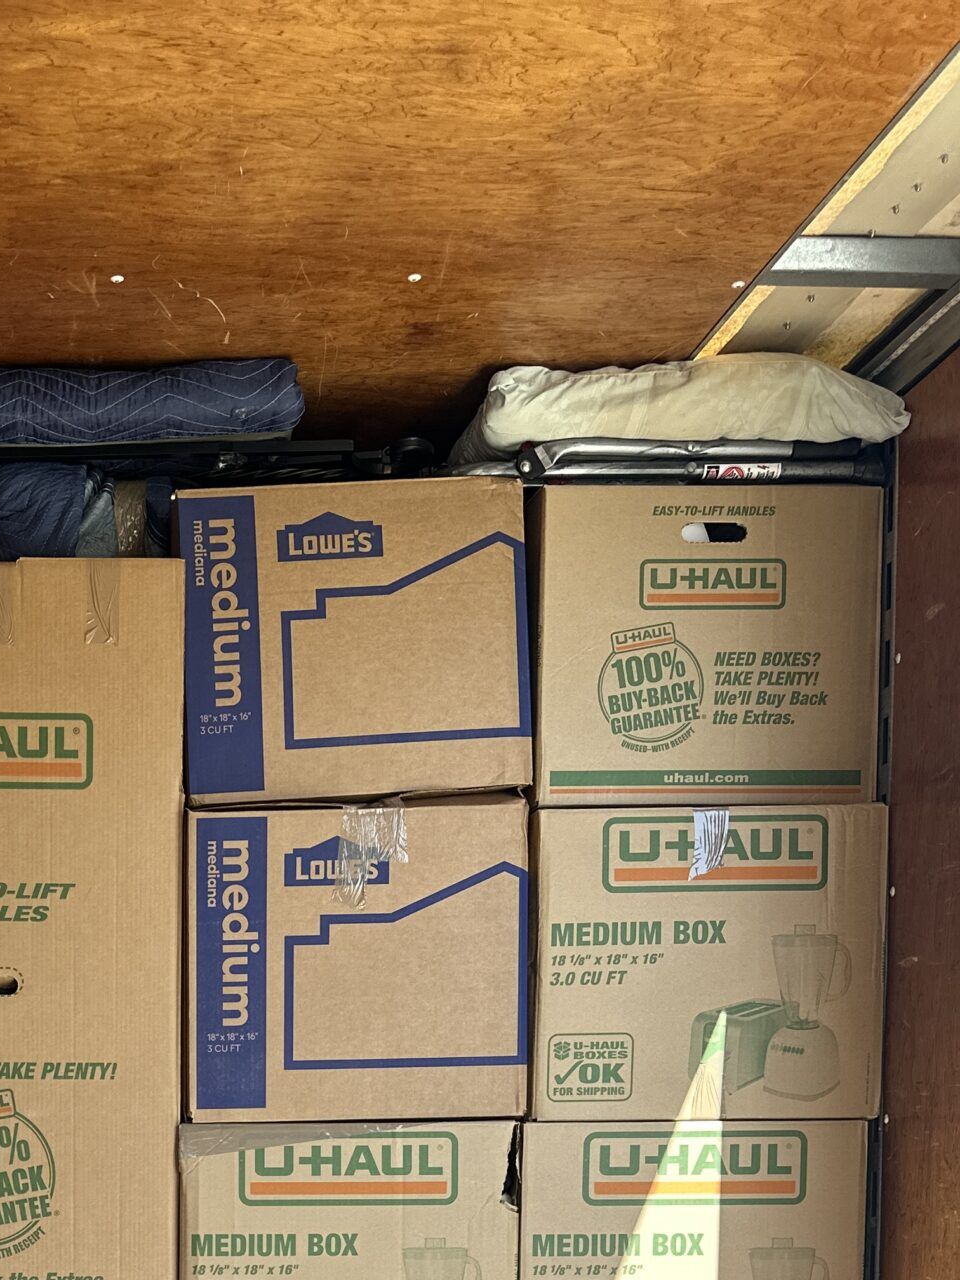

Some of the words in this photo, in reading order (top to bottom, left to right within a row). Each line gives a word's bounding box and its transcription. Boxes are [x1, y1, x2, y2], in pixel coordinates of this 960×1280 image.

[652, 505, 725, 517] EASY-TO-LIFT
[726, 505, 776, 517] HANDLES
[193, 520, 205, 587] mediana
[288, 529, 373, 556] LOWE'S
[650, 567, 777, 589] U-HAUL
[208, 518, 251, 707] medium
[200, 726, 206, 735] 3
[208, 725, 222, 734] CU
[223, 725, 233, 733] FT
[663, 772, 749, 784] uhaul.com
[207, 841, 220, 908] mediana
[222, 839, 260, 1027] medium
[551, 921, 662, 947] MEDIUM
[673, 920, 727, 945] BOX
[573, 1041, 628, 1051] U-HAUL
[573, 1050, 628, 1060] BOXES
[41, 1062, 118, 1080] PLENTY!
[578, 1063, 625, 1085] OK
[553, 1087, 573, 1096] FOR
[576, 1087, 625, 1096] SHIPPING
[254, 1144, 443, 1176] U-HAUL
[599, 1144, 792, 1176] U-HAUL
[13, 1227, 46, 1257] RECEIPT
[191, 1233, 297, 1256] MEDIUM
[307, 1233, 359, 1256] BOX
[532, 1233, 641, 1257] MEDIUM
[652, 1233, 704, 1256] BOX
